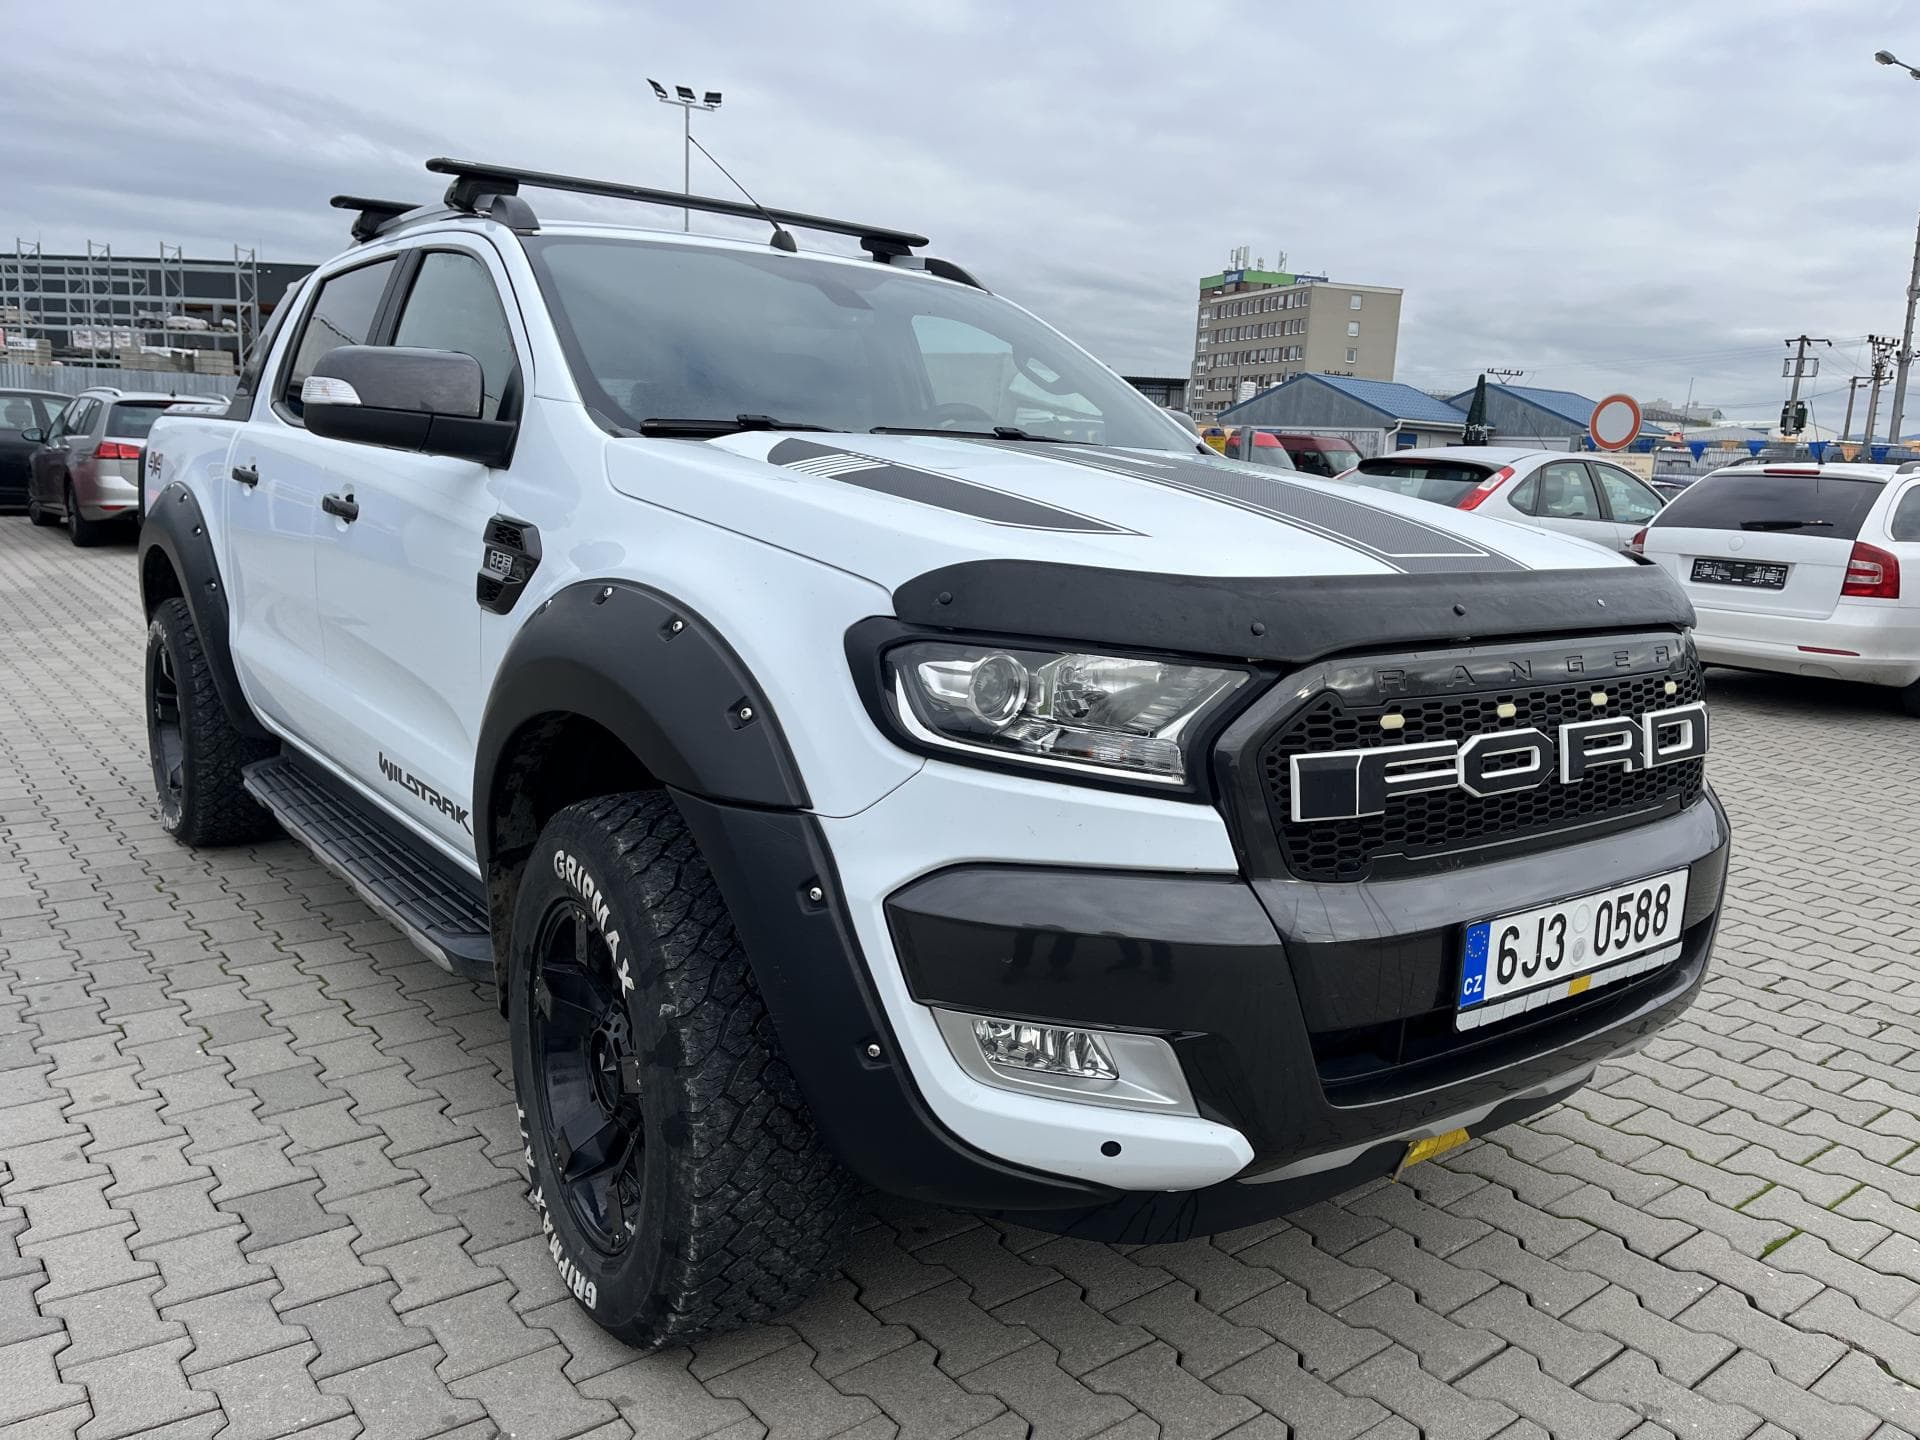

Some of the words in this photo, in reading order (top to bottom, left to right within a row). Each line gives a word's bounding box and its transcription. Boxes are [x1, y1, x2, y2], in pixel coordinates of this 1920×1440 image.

[1375, 646, 1671, 693] RANGER
[378, 751, 473, 836] WILDTRAK
[1290, 700, 1710, 822] FORD
[553, 849, 635, 999] GRIPMAX
[1496, 913, 1567, 985] 6J3
[1593, 883, 1671, 956] 0588
[1463, 975, 1483, 996] CZ
